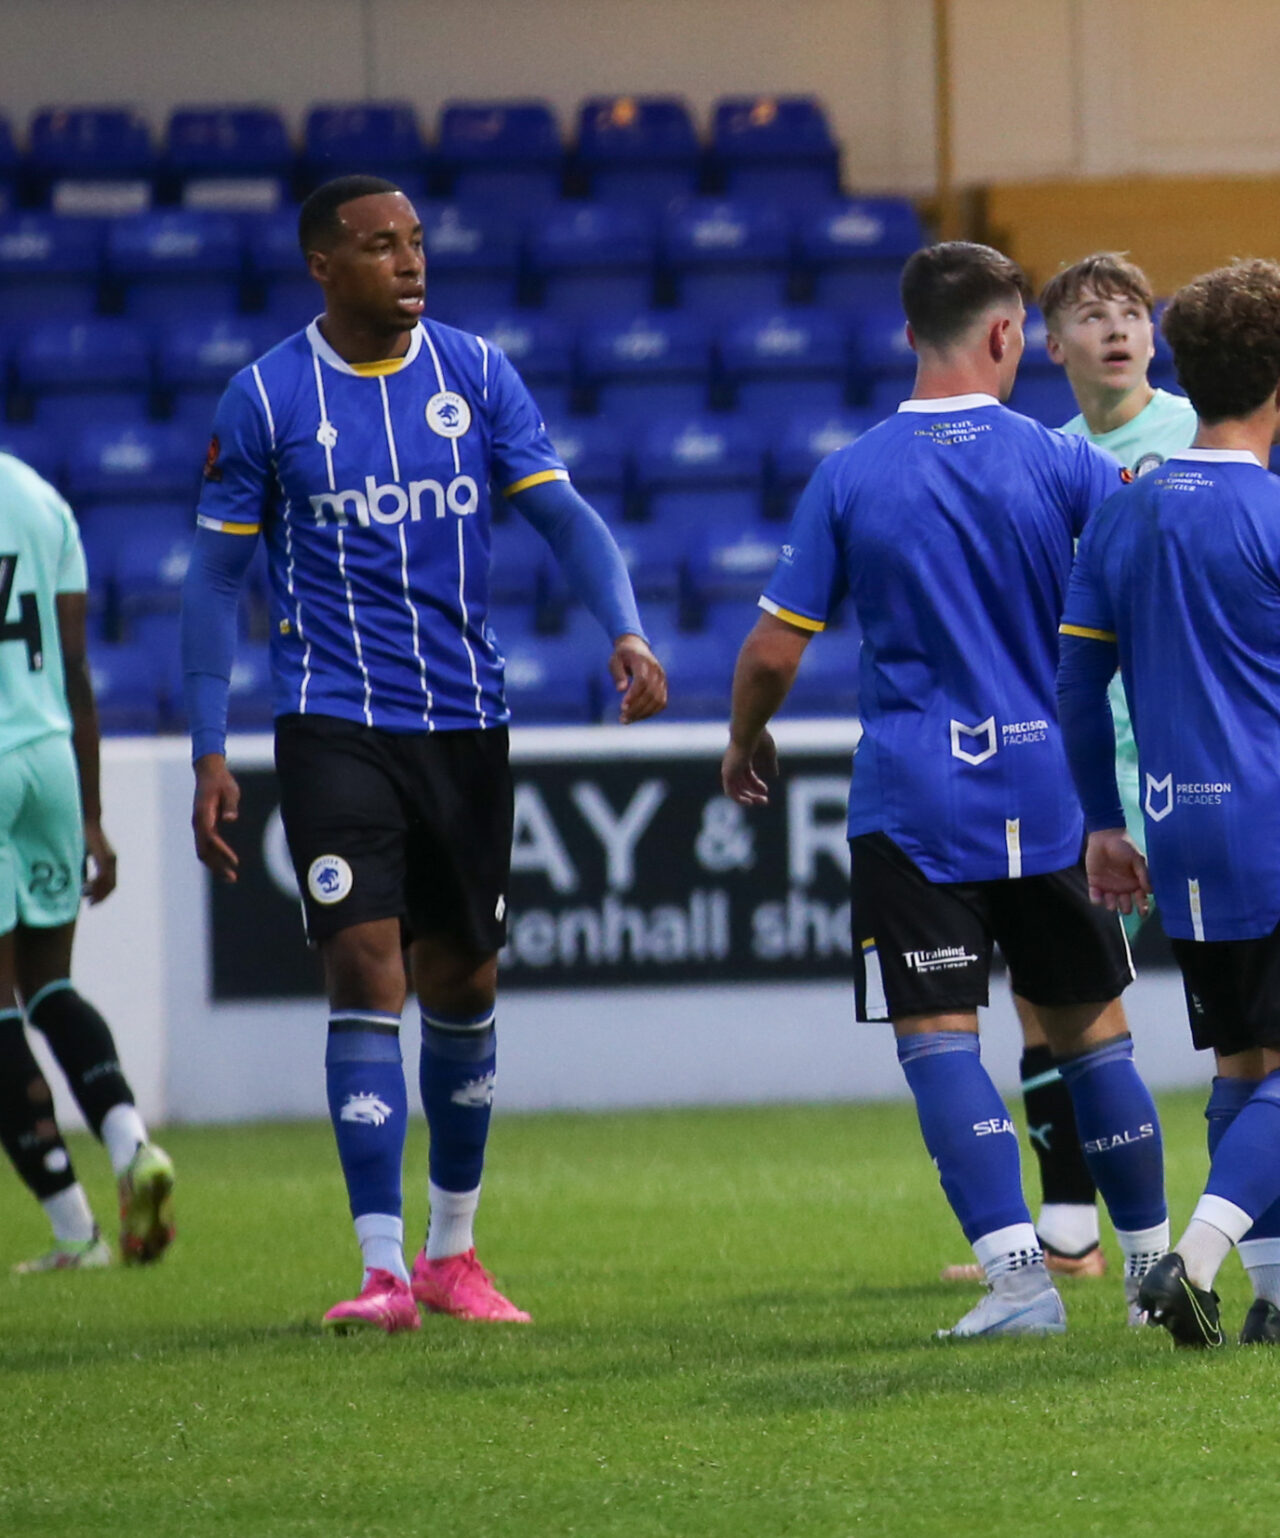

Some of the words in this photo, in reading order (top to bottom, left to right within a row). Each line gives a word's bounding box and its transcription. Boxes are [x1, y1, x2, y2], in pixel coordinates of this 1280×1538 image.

[308, 475, 479, 528] mbna
[1002, 720, 1048, 735] PRECISION
[1003, 731, 1046, 746] FACADES
[1176, 783, 1231, 793] PRECISION
[1176, 795, 1222, 805] FACADES
[695, 796, 757, 871] &
[498, 888, 731, 968] enhall
[1085, 1123, 1154, 1154] SEALS
